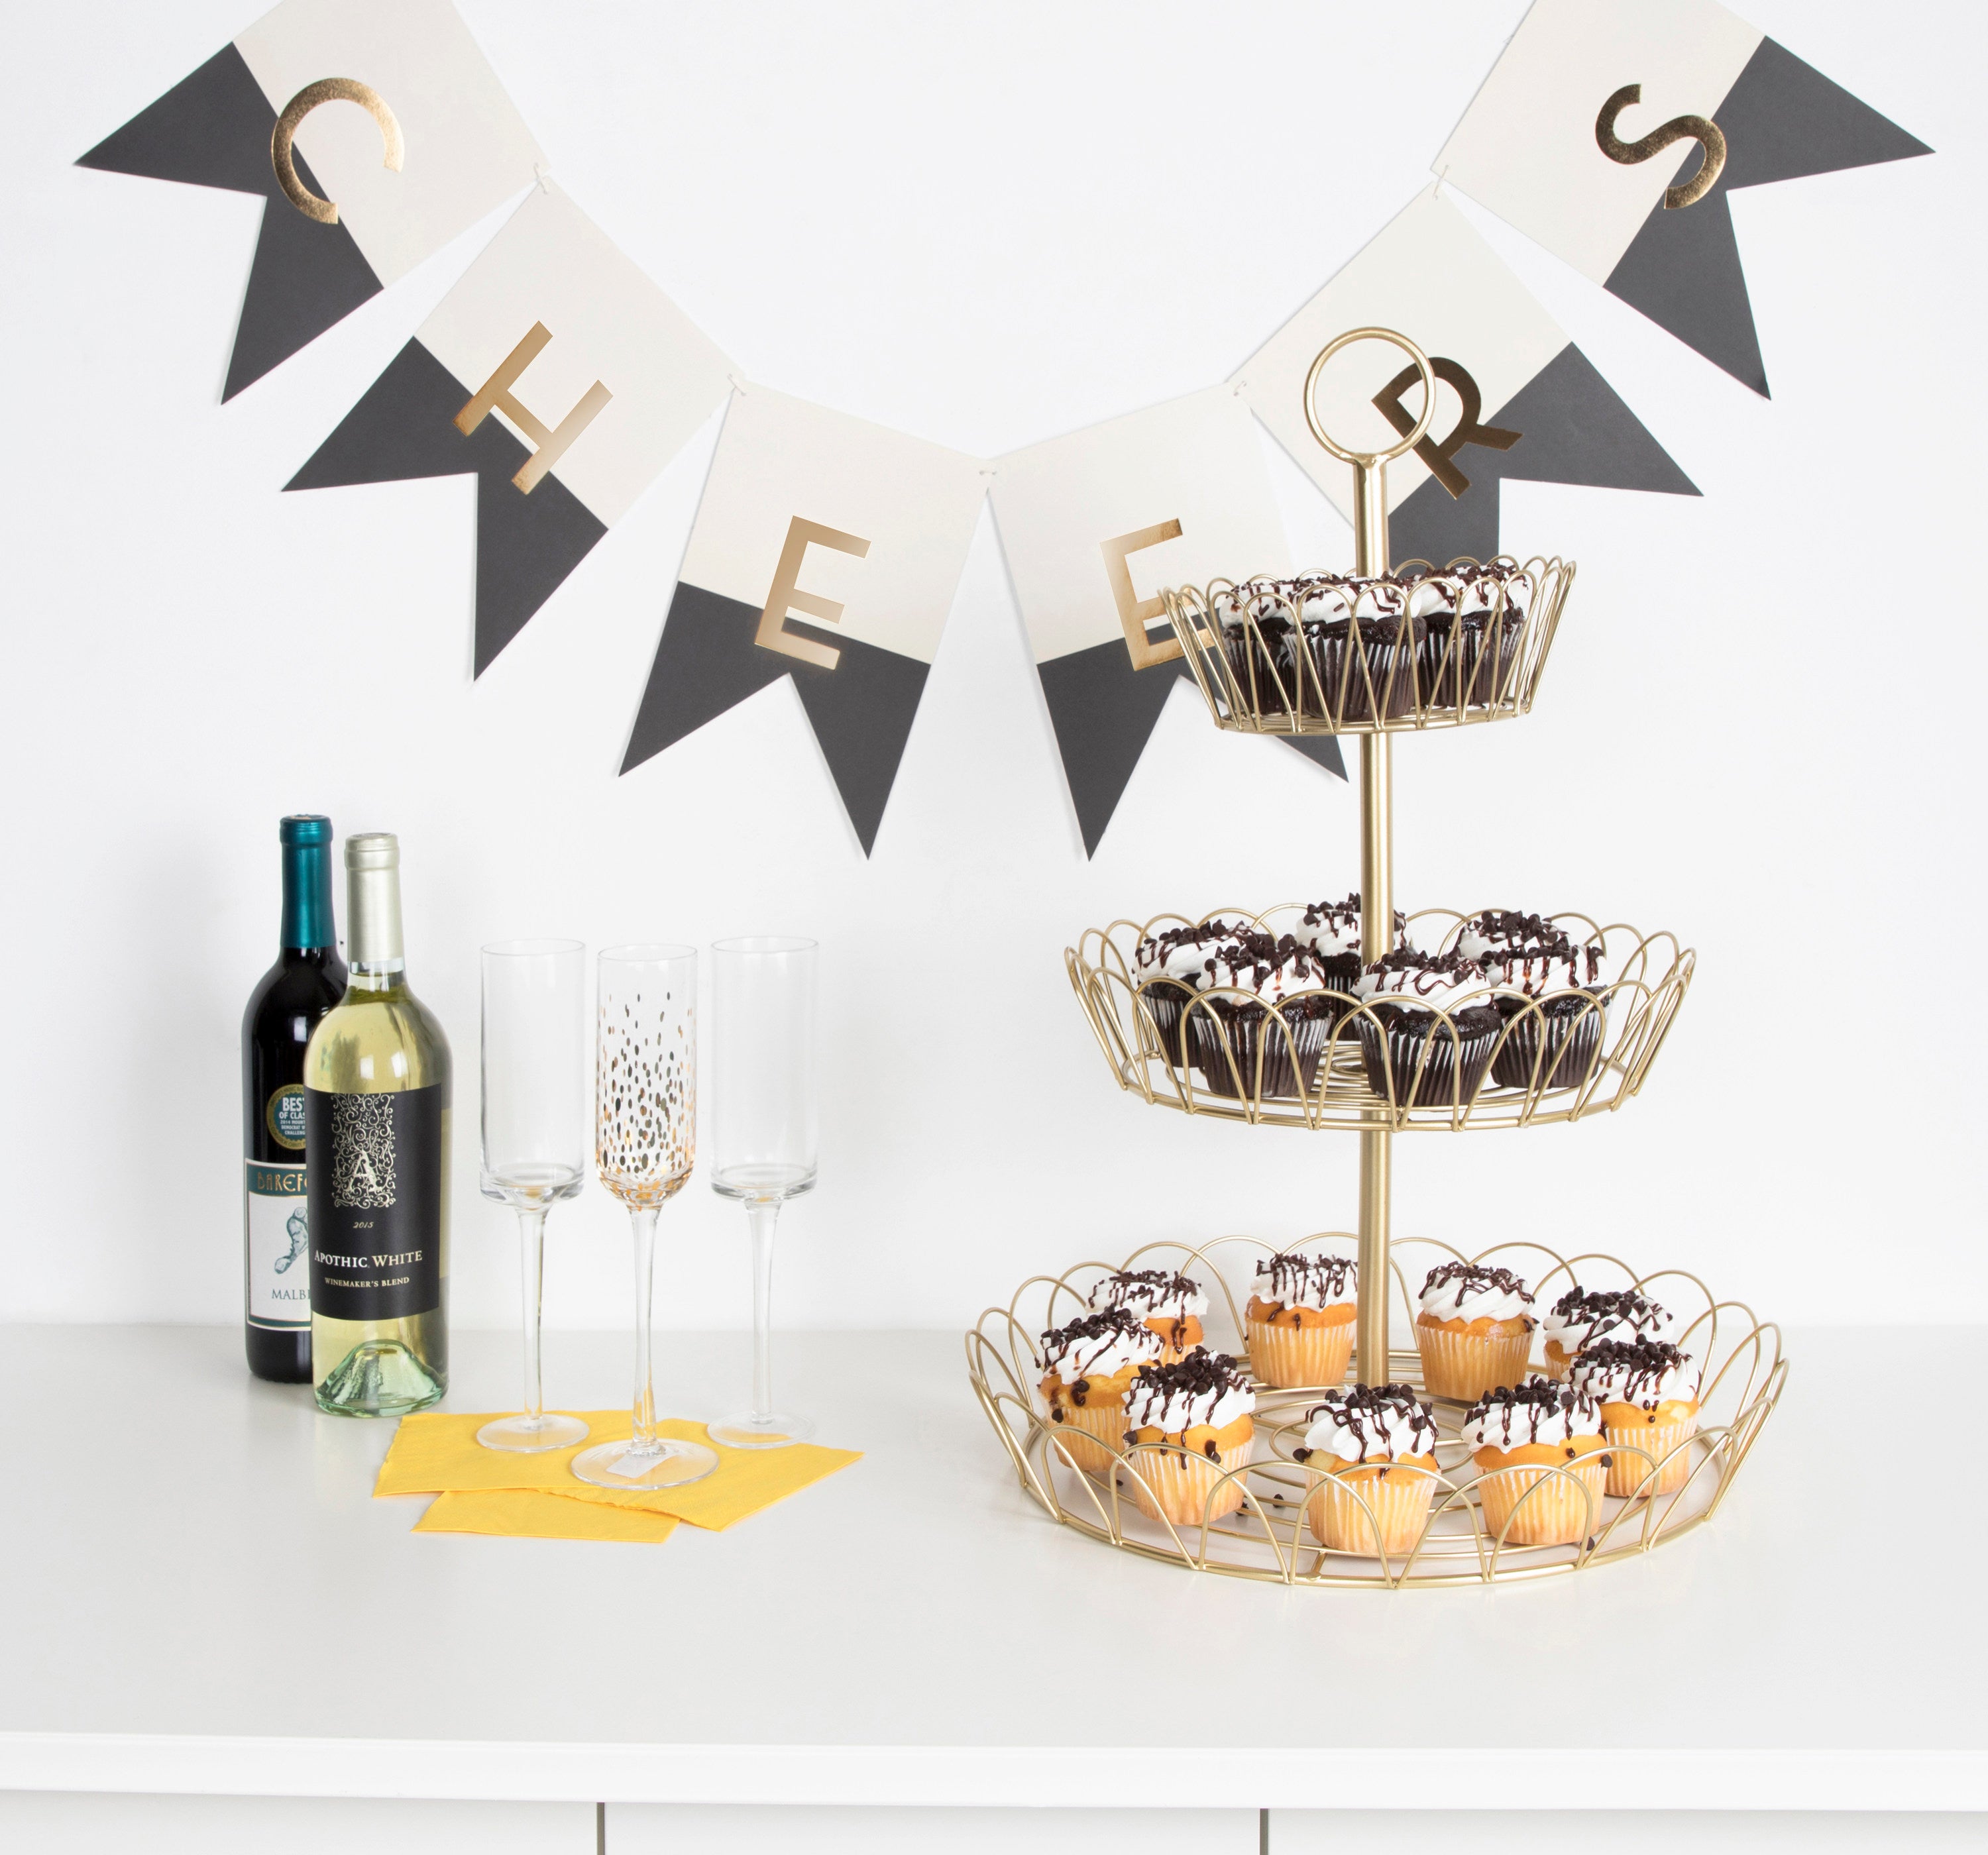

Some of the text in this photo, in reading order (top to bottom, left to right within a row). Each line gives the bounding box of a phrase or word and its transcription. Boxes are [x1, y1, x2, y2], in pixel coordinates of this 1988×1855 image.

[271, 77, 1727, 671] CHEERS
[257, 1172, 307, 1192] BAREF
[314, 1249, 423, 1268] APOTHIC WHITE
[324, 1277, 410, 1288] WINEMAKER'S BLEND
